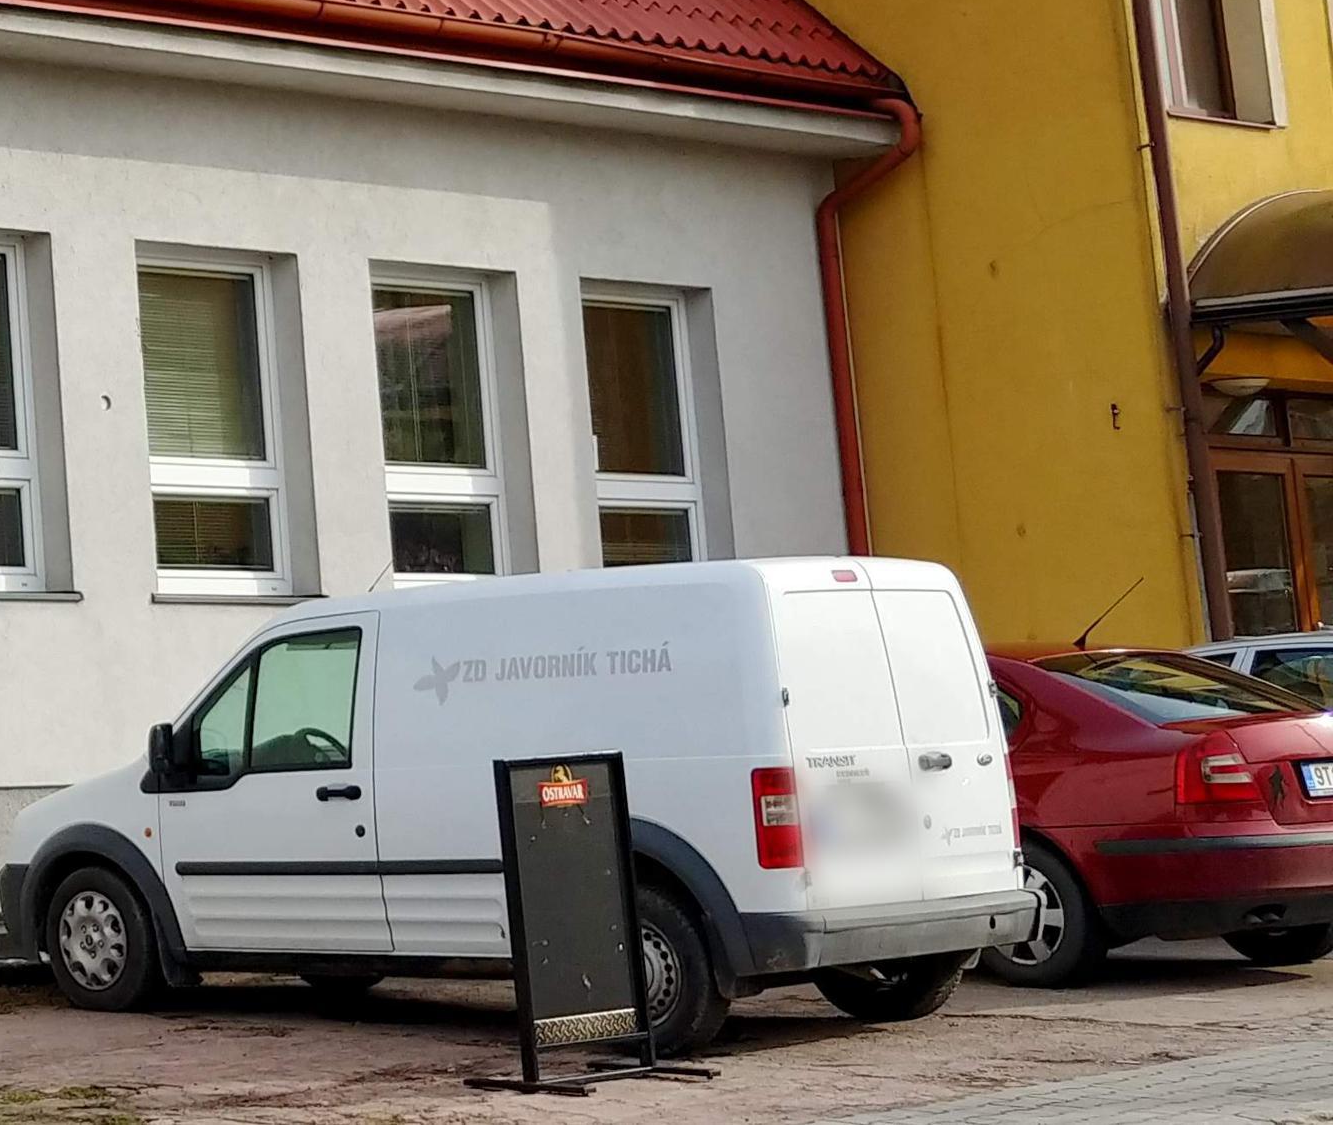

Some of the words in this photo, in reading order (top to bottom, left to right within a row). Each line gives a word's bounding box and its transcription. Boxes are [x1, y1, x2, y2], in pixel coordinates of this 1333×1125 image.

[462, 659, 487, 683] ZD
[495, 646, 597, 681] JAVORNÍK
[606, 640, 672, 675] TICHÁ
[542, 784, 584, 802] OSTRAVAR
